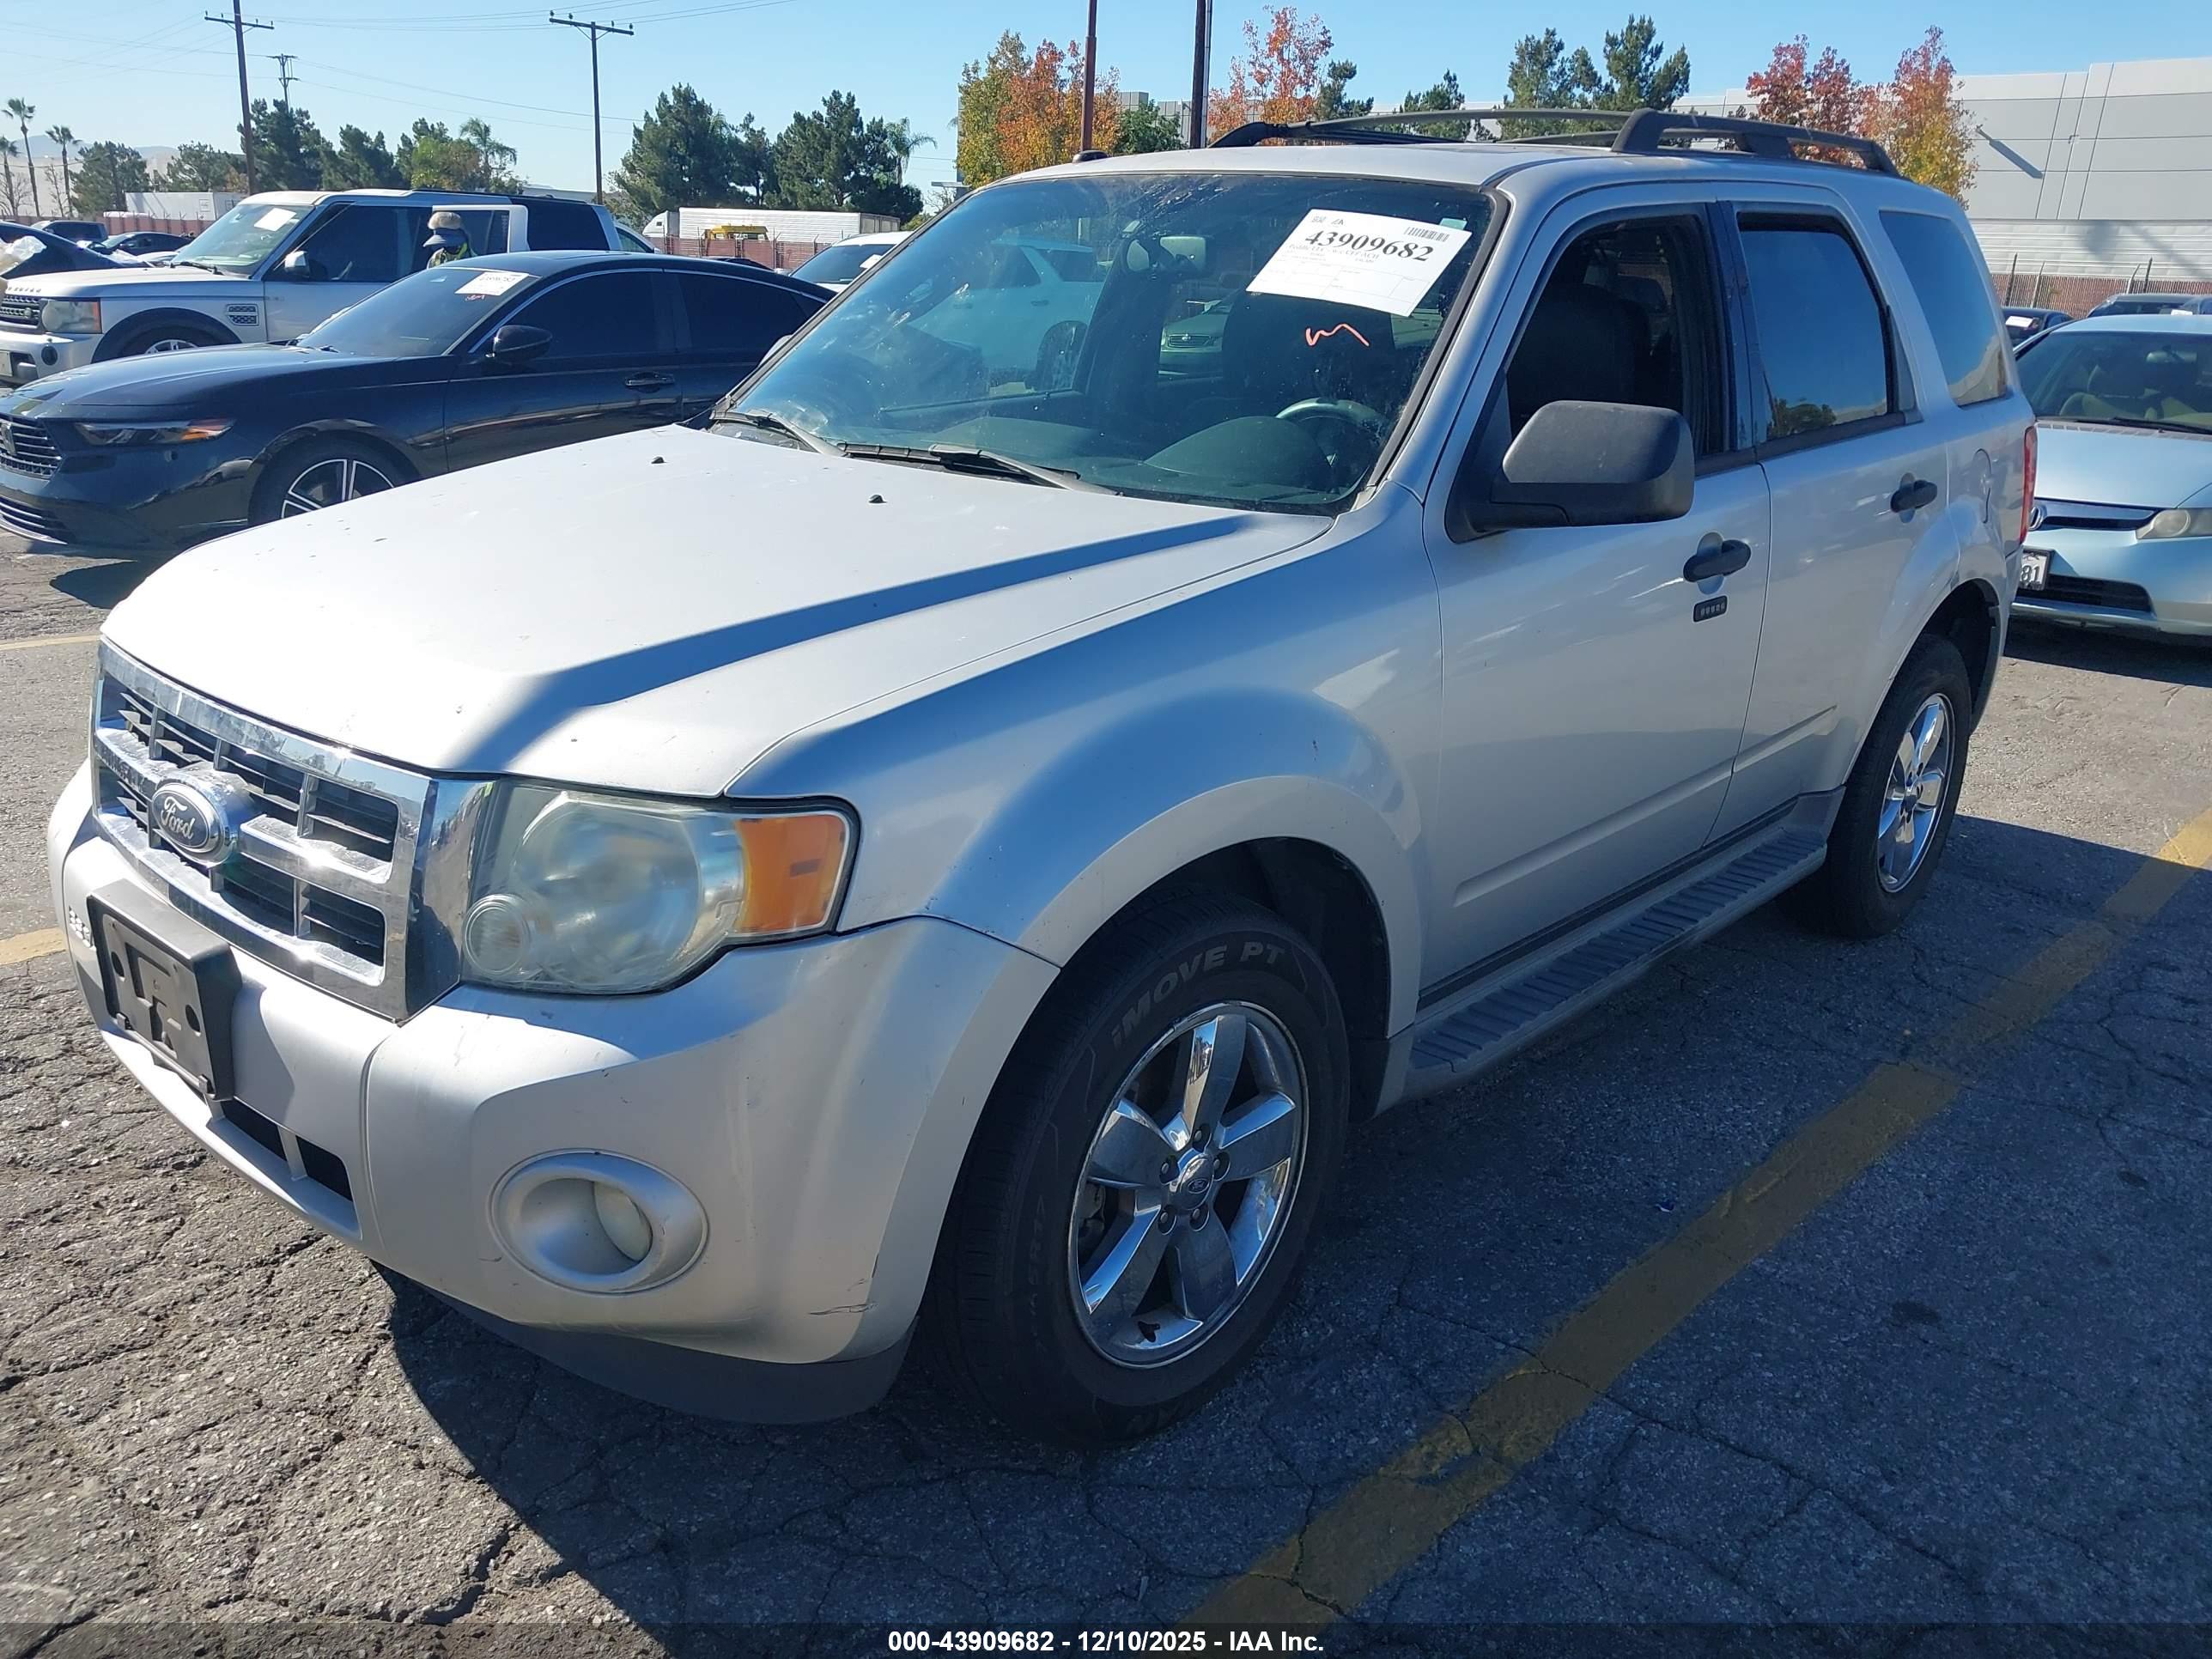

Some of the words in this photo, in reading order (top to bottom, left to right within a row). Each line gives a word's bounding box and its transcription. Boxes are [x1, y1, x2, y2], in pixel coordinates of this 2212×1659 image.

[1304, 230, 1434, 262] 43909682
[160, 795, 196, 840] Ford
[1239, 941, 1286, 964] PT
